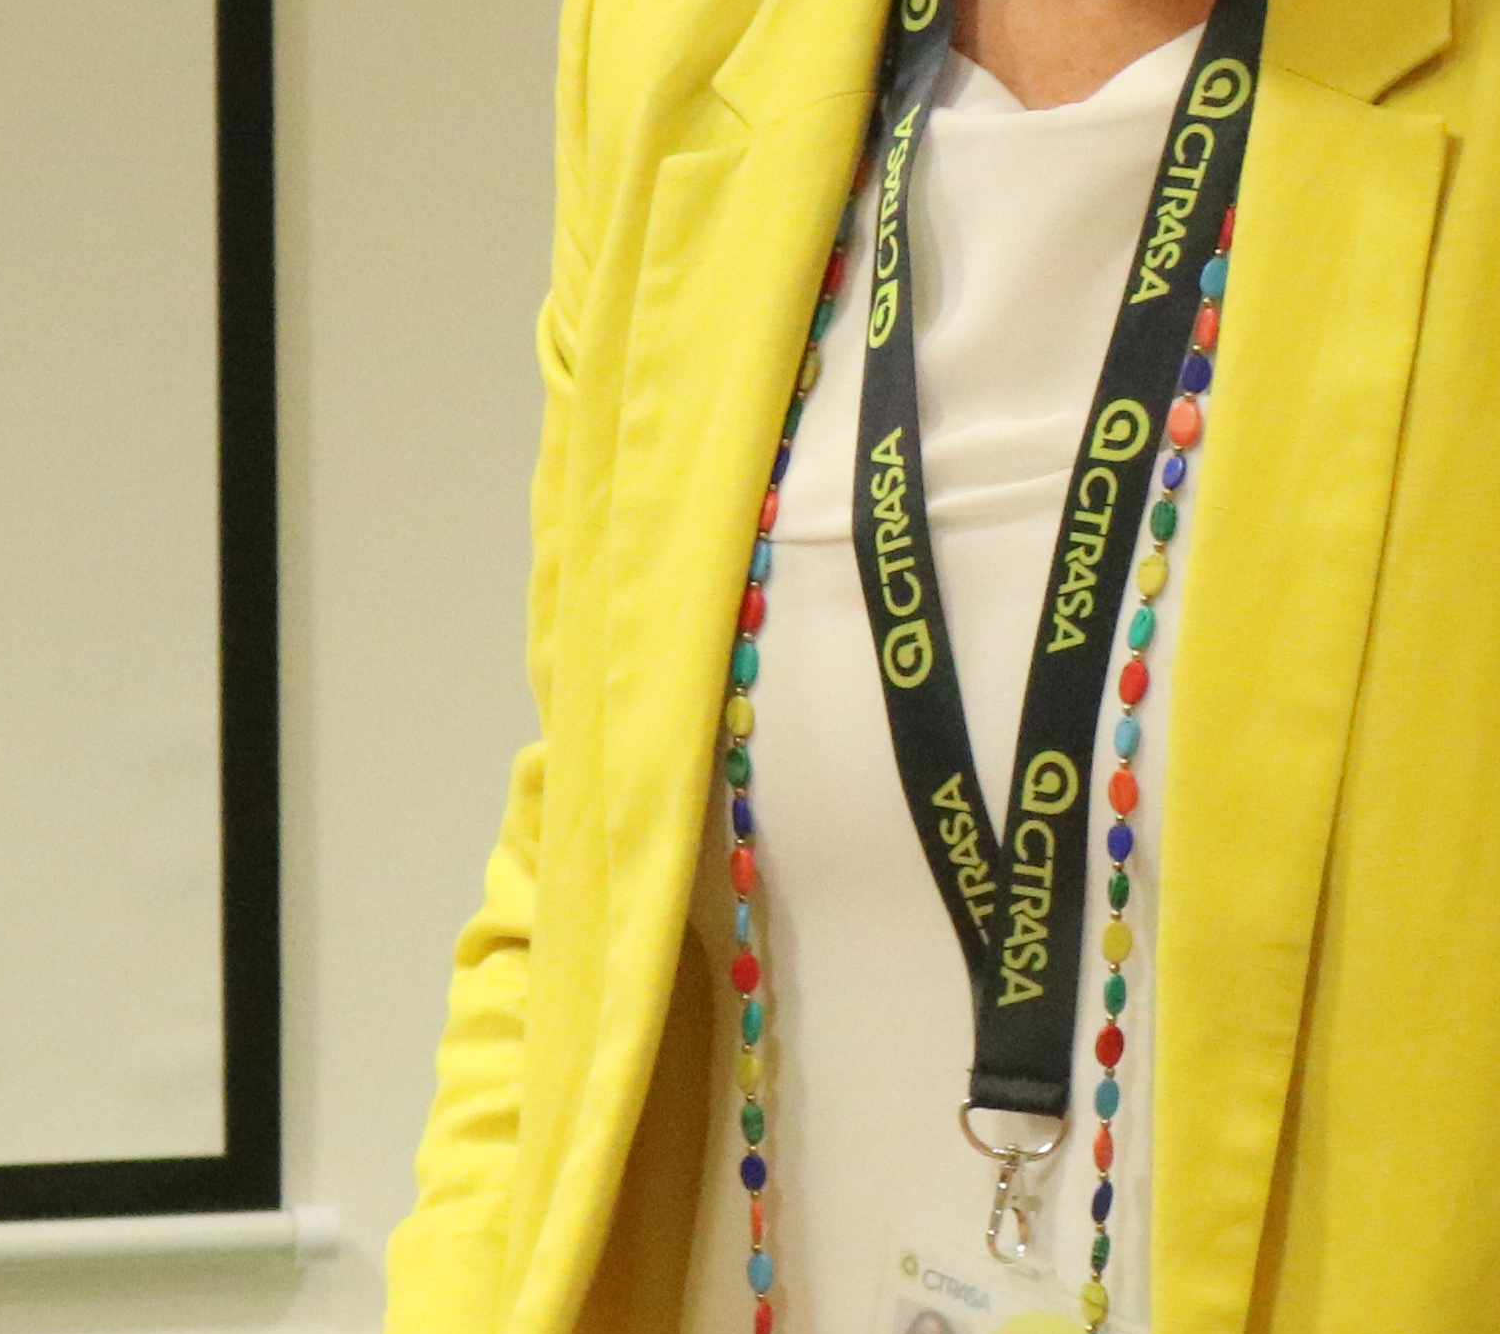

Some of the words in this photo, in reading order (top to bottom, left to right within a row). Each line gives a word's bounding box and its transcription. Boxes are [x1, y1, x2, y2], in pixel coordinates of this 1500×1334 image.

[876, 104, 921, 279] CTRASA
[1128, 123, 1216, 304] CTRASA
[869, 427, 922, 617] CTRASA
[1047, 467, 1118, 653] CTRASA
[932, 773, 998, 945] TRASA
[997, 820, 1055, 1006] CTRASA
